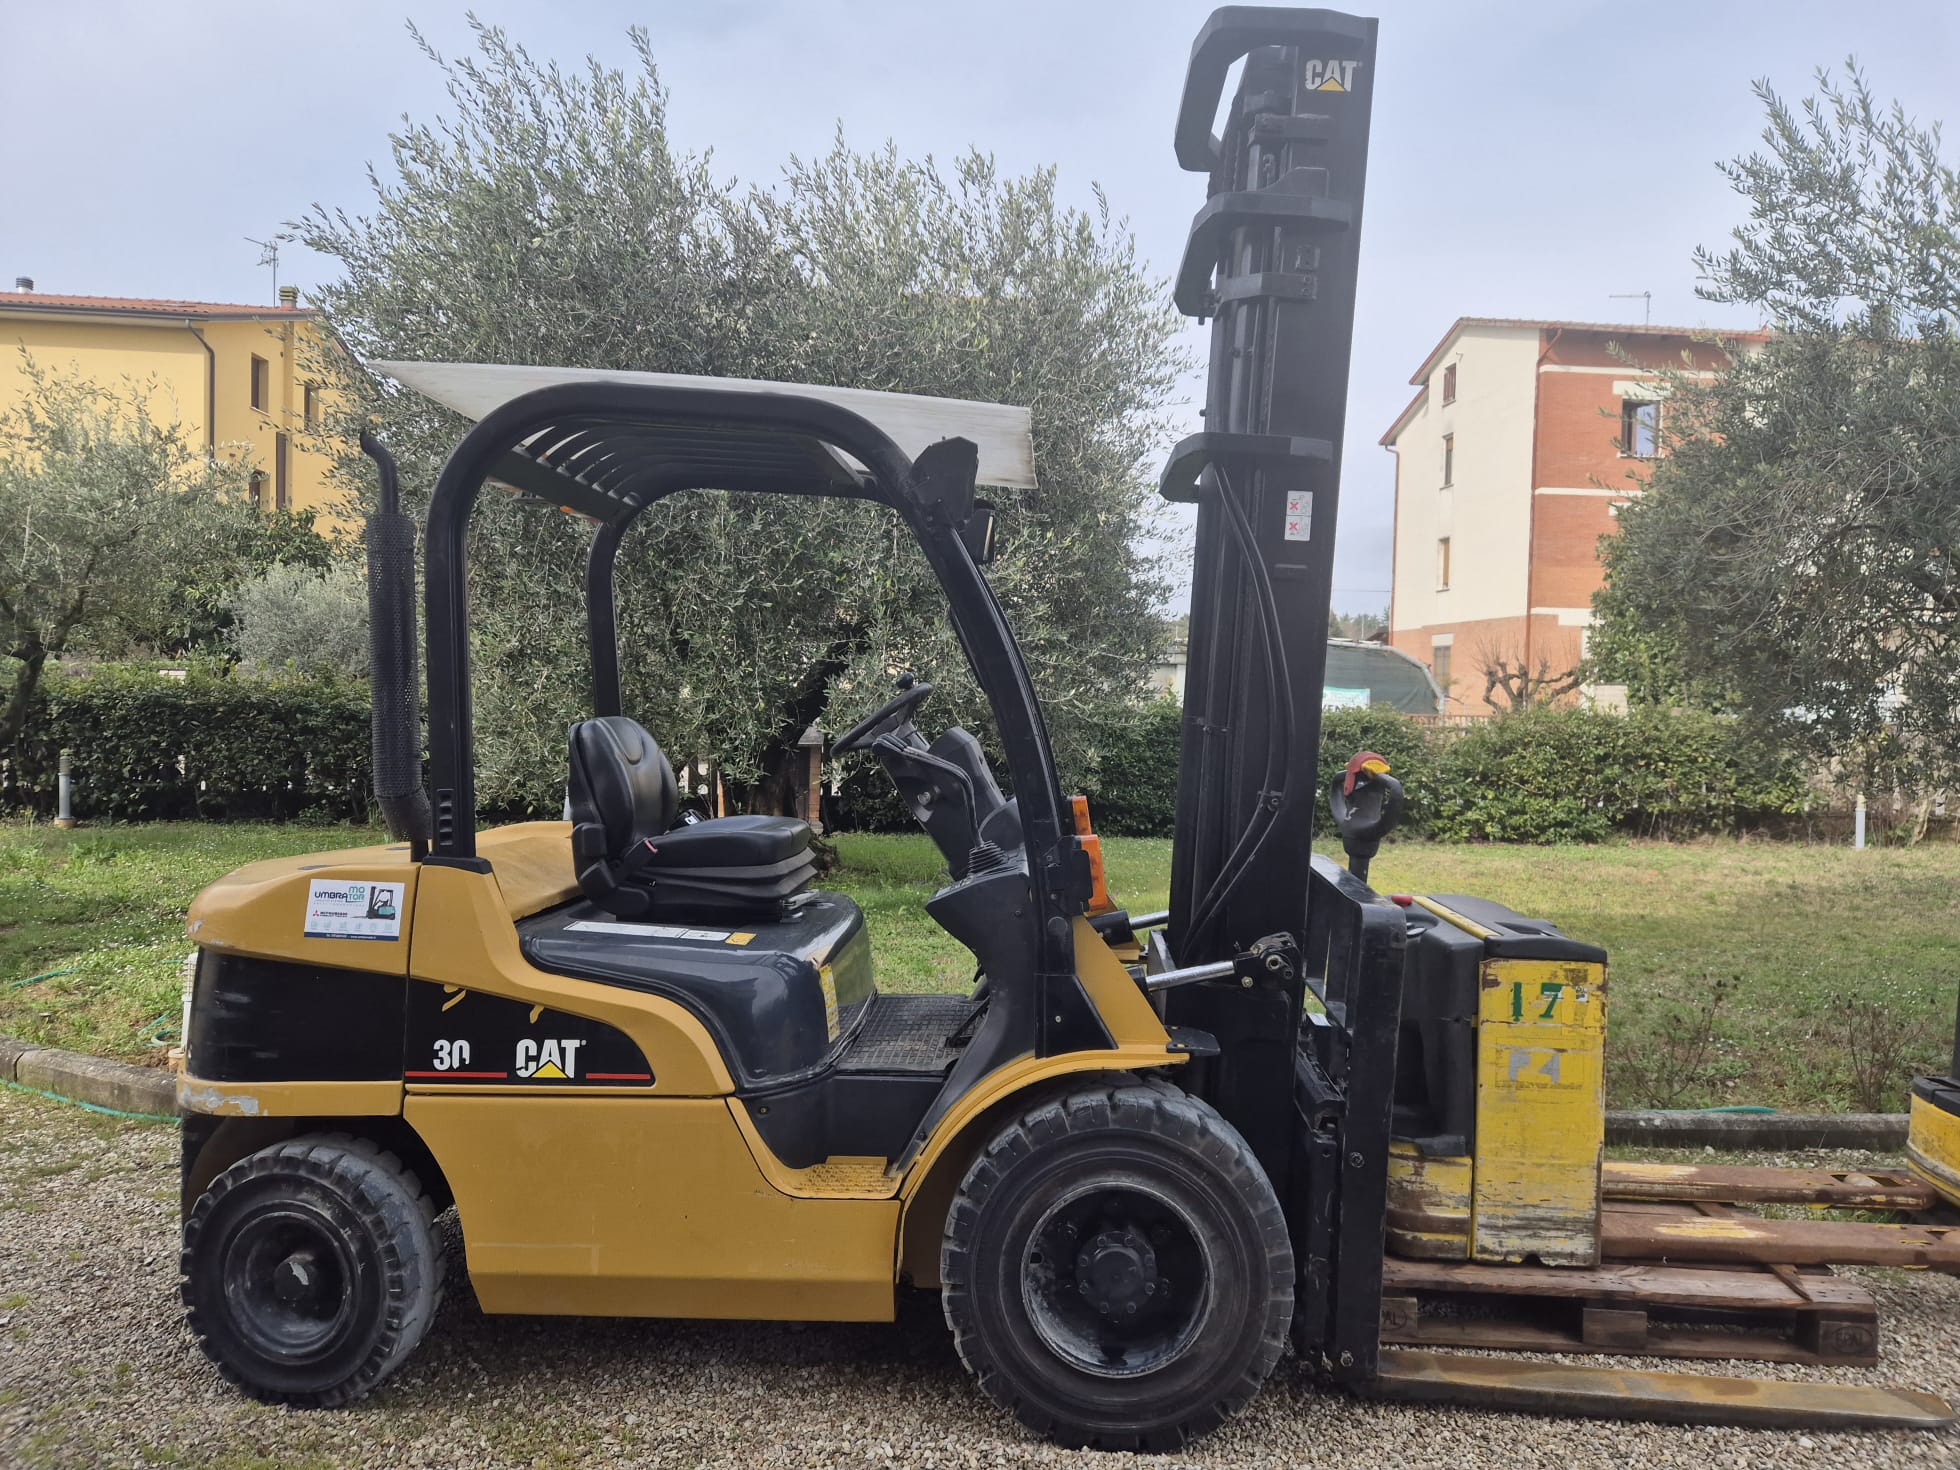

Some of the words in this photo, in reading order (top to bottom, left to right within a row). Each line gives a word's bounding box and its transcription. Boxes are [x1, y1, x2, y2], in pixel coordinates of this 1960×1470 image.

[1305, 59, 1357, 92] CAT
[314, 891, 348, 901] UMBRA
[348, 886, 365, 894] MO
[433, 1039, 470, 1071] 30
[515, 1038, 581, 1079] CAT
[1508, 1050, 1561, 1084] P4
